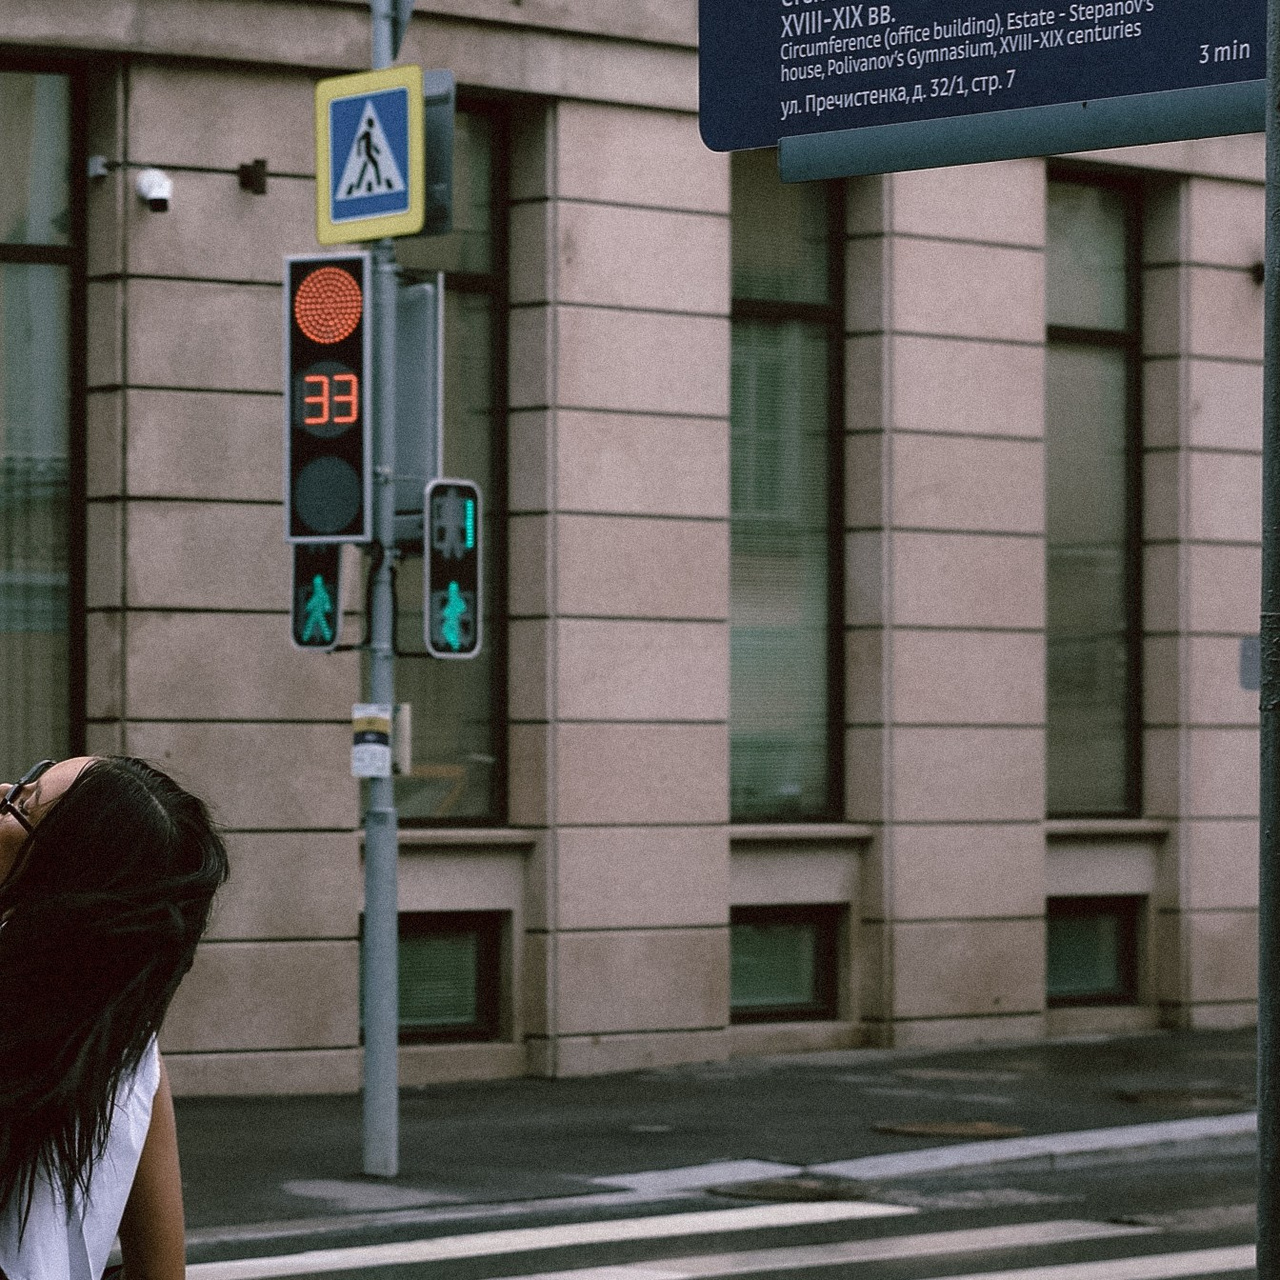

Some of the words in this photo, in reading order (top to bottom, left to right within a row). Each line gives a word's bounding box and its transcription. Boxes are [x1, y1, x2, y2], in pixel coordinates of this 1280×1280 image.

[780, 34, 882, 60] Circumference
[884, 25, 930, 50] (office
[933, 13, 1004, 40] building),
[1007, 9, 1055, 30] Estate
[868, 5, 896, 26] вв.
[781, 64, 825, 82] house,
[907, 40, 997, 69] Gymnasium,
[1066, 20, 1142, 45] centuries
[1199, 44, 1210, 64] 3
[1214, 39, 1250, 62] min
[780, 100, 802, 121] ул.
[805, 86, 910, 117] Пречистенка,
[911, 84, 927, 103] д.
[930, 75, 969, 97] 32/1,
[971, 75, 1003, 96] стр.
[1006, 69, 1016, 88] 7
[304, 373, 359, 424] 33
